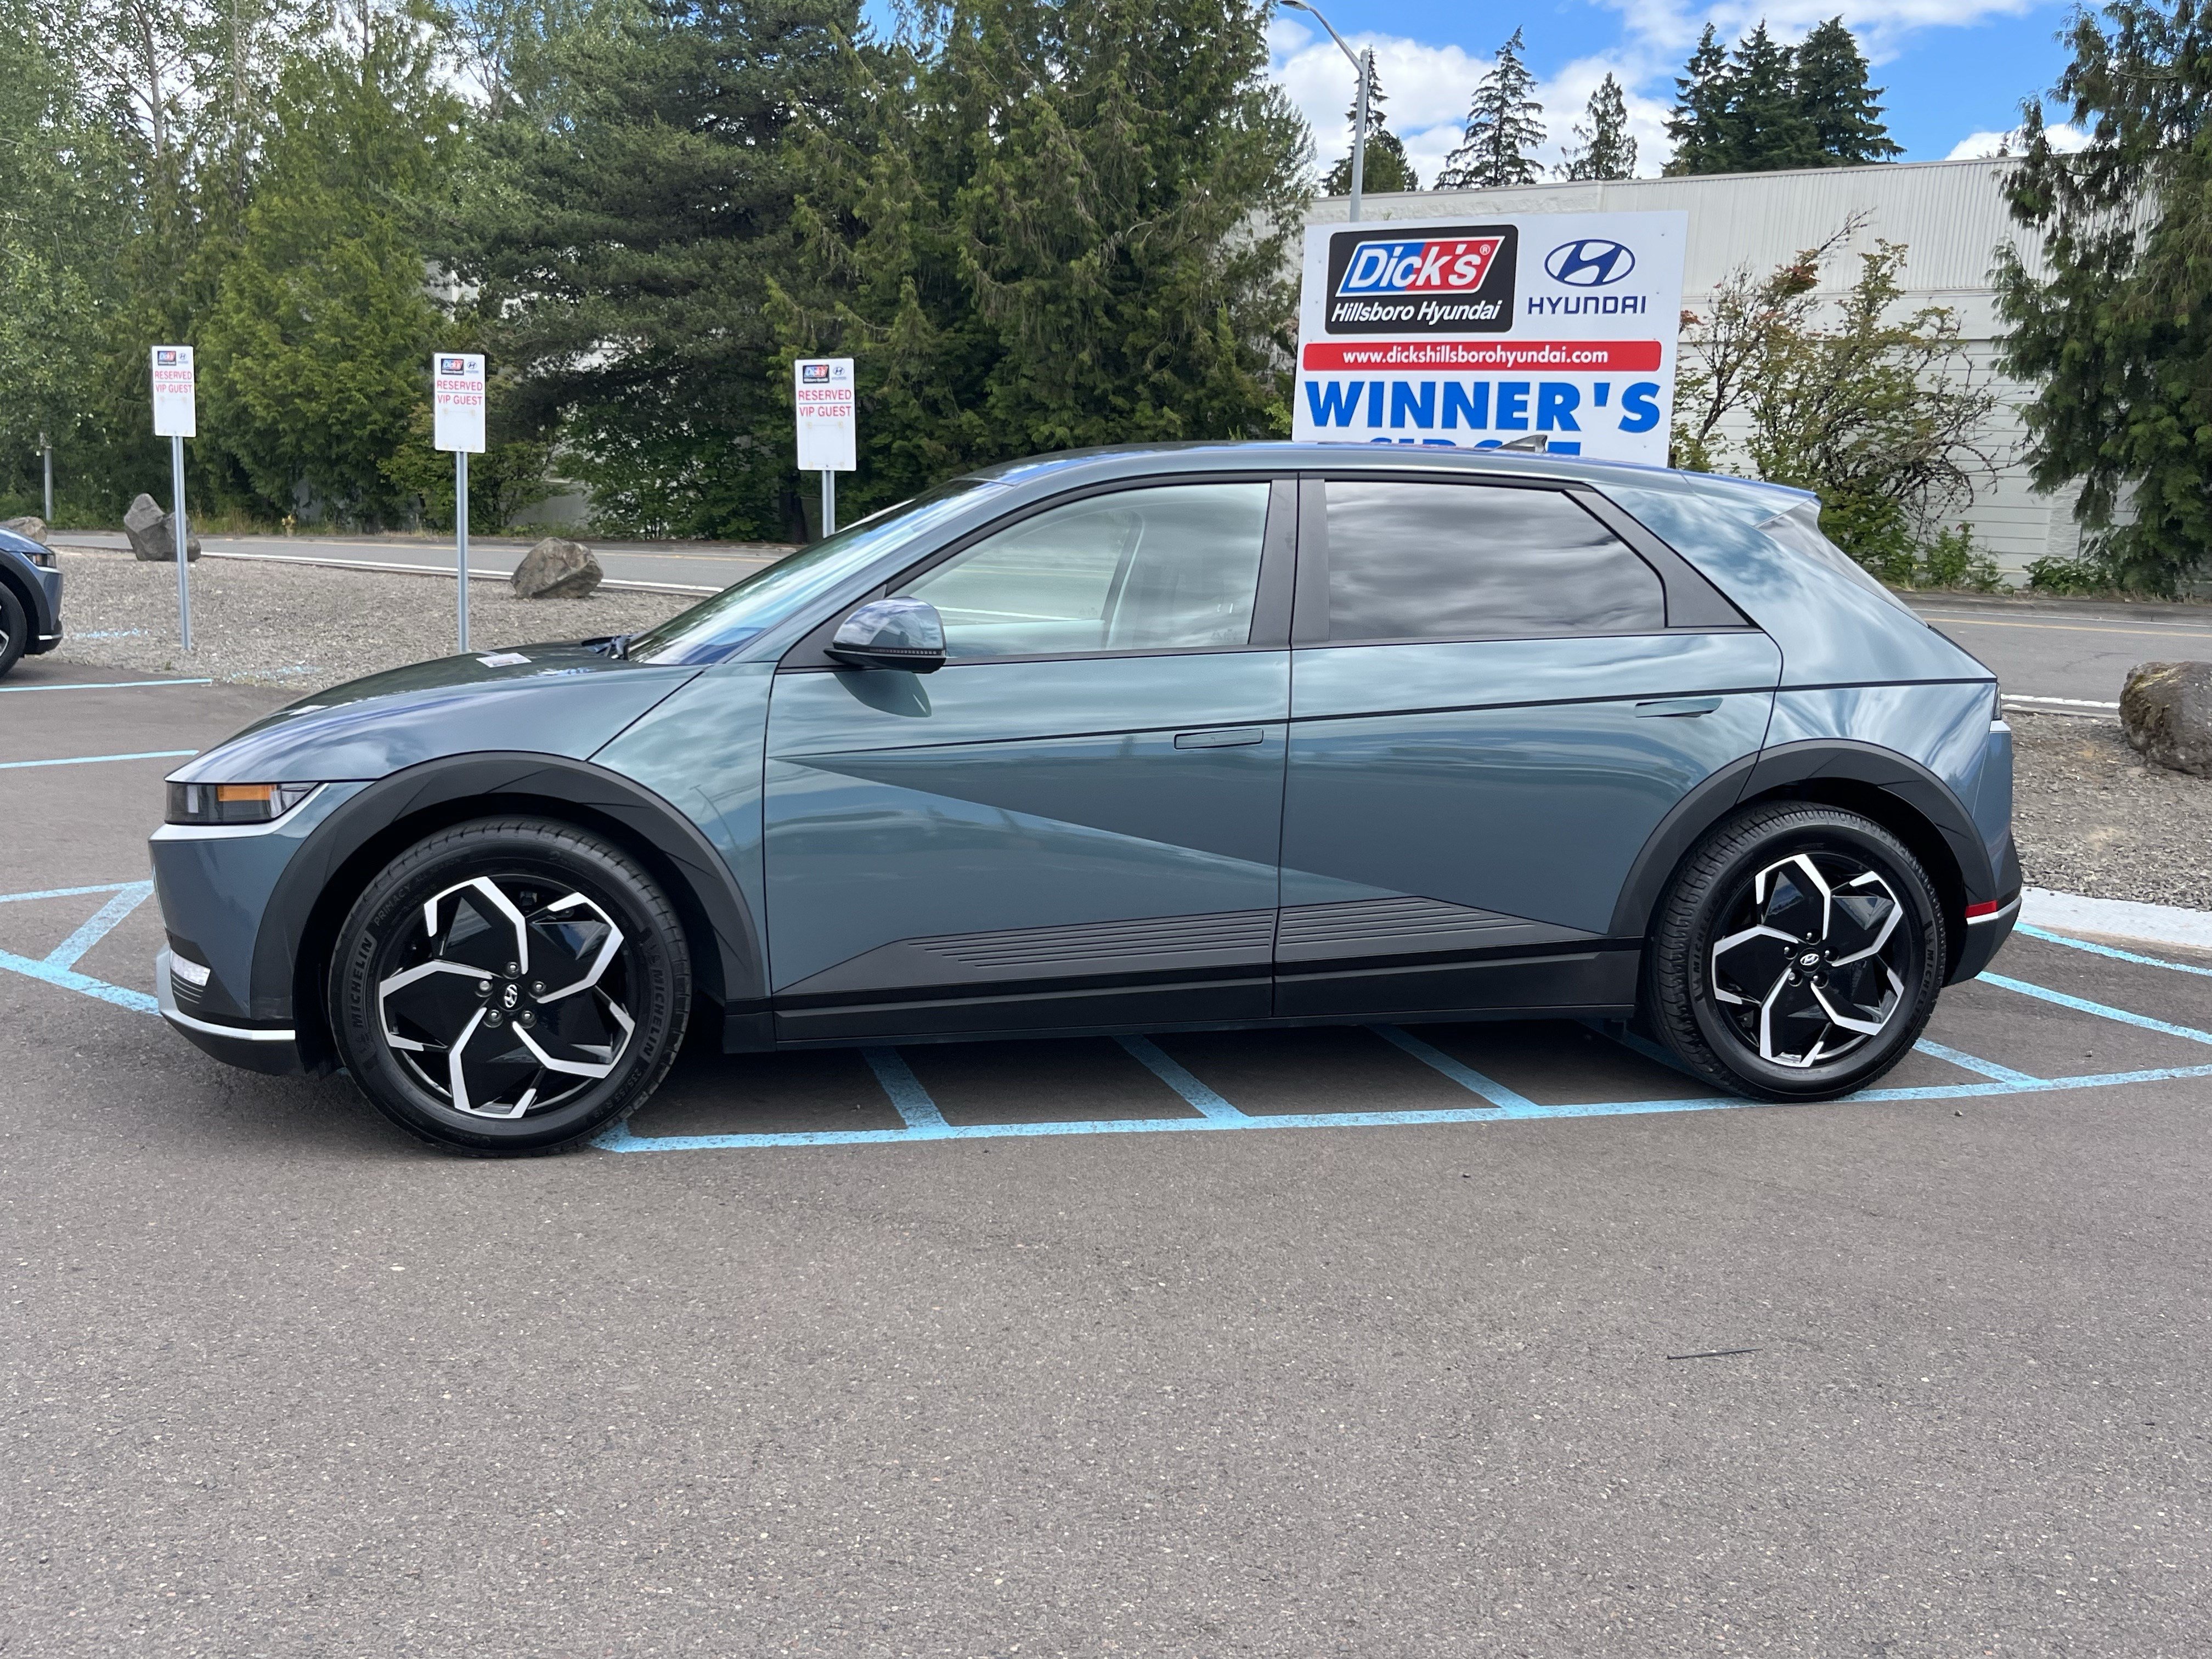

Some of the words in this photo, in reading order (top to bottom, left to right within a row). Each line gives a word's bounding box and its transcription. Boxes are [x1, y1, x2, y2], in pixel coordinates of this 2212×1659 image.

[1348, 243, 1481, 289] Dick's
[1331, 302, 1414, 323] Hillsboro
[1417, 300, 1503, 325] Hyundai
[1528, 296, 1646, 315] HYUNDAI
[1342, 345, 1609, 368] www.dickshillsborohyundai.com
[155, 371, 192, 380] RESERVED
[168, 385, 192, 393] GUEST
[437, 380, 483, 391] RESERVED
[798, 390, 851, 400] RESERVED
[437, 394, 450, 403] VIP
[453, 395, 482, 405] GUEST
[1304, 381, 1661, 433] WINNER'S
[799, 407, 815, 417] VIP
[818, 406, 851, 417] GUEST
[349, 936, 373, 1029] MICHELIN
[643, 969, 665, 1057] MICHELIN
